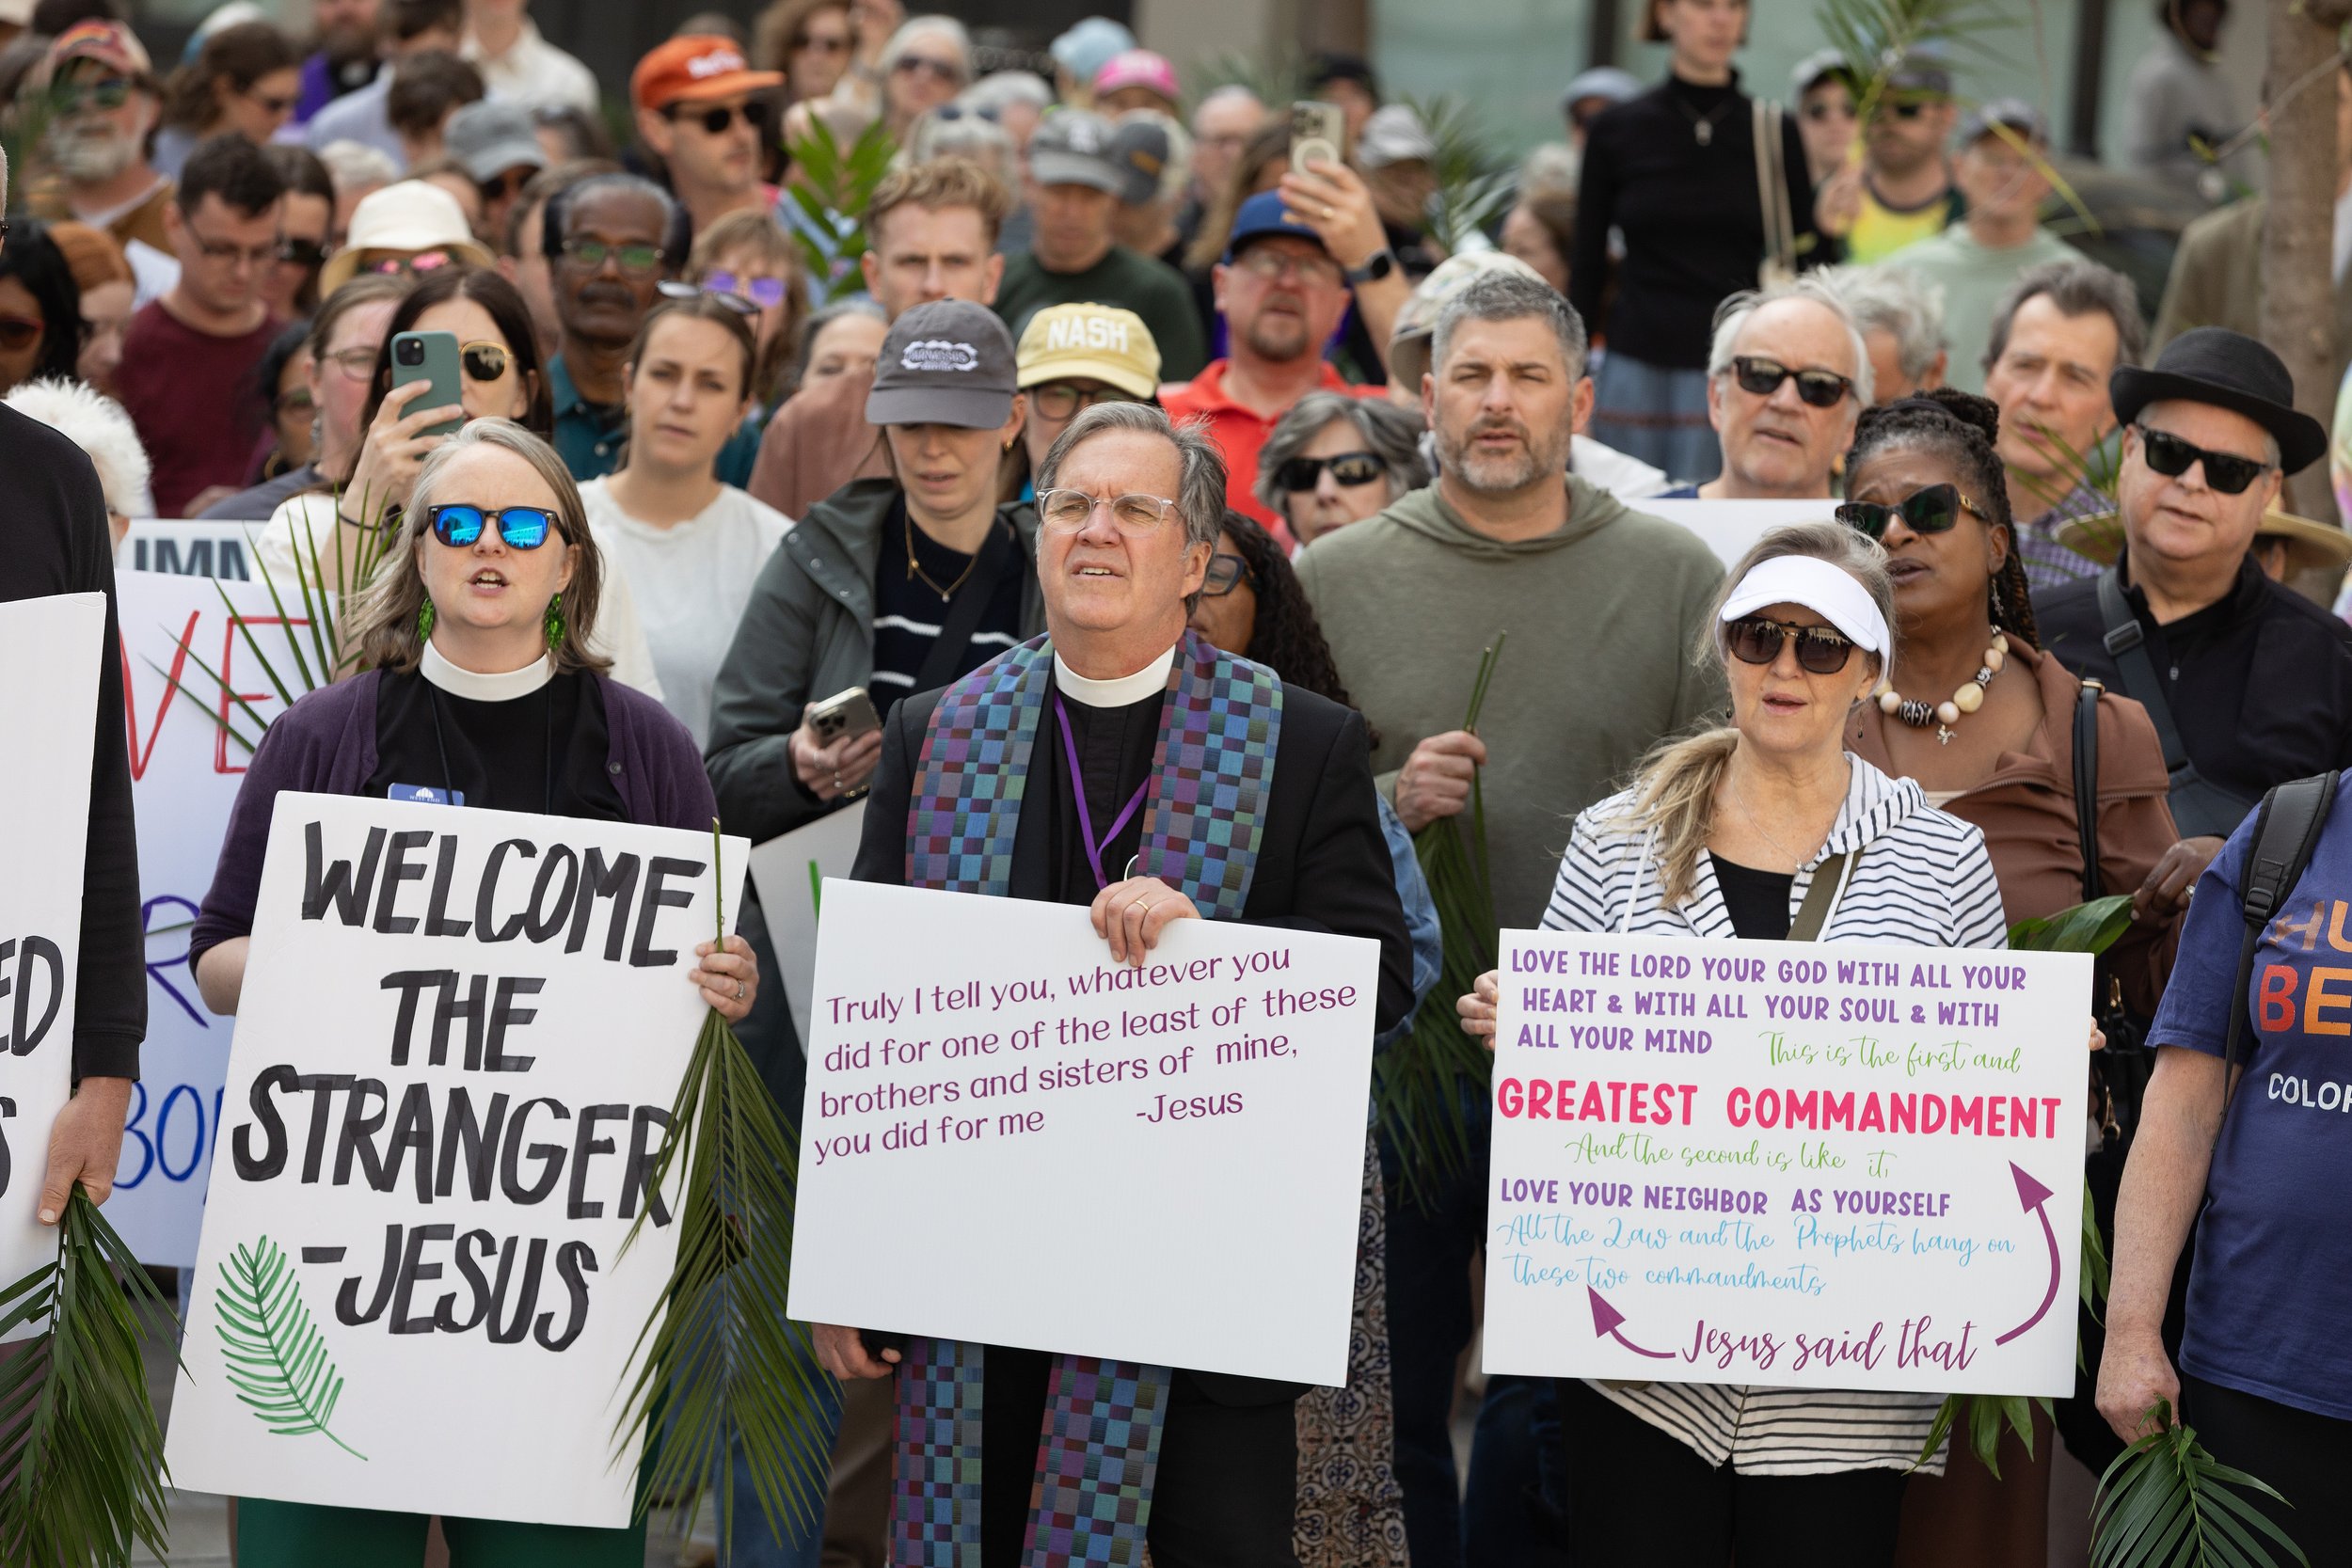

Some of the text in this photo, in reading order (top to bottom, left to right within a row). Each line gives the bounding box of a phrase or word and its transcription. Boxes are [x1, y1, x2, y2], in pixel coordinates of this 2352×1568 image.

[1047, 315, 1129, 354] NASH
[302, 821, 707, 967] WELCOME
[825, 948, 1290, 1025] Truly I tell you, whatever you
[1512, 948, 2026, 990] LOVE THE LORD YOUR GOD WITH ALL YOUR
[381, 970, 546, 1071] THE
[1522, 987, 1999, 1027] HEART & WITH ALL YOUR SOUL & WITH
[2259, 964, 2352, 1037] BE
[824, 986, 1356, 1072] did for one of the least of these
[1518, 1023, 1712, 1054] ALL YOUR MIND
[1758, 1031, 2020, 1077] This is the first and
[820, 1033, 1297, 1121] brothers and sisters of mine,
[1497, 1077, 2061, 1139] GREATEST COMMANDMENT
[113, 1082, 225, 1206] BO
[232, 1065, 679, 1227] STRANGER
[814, 1133, 870, 1165] you
[882, 1118, 928, 1150] did
[940, 1116, 989, 1144] for
[999, 1111, 1044, 1136] me
[1565, 1132, 1629, 1164] And
[1623, 1132, 1674, 1164] the
[1681, 1139, 1758, 1166] second
[1767, 1149, 1793, 1172] is
[1801, 1141, 1846, 1169] like
[1501, 1178, 1950, 1217] LOVE YOUR NEIGHBOR AS YOURSELF
[1496, 1212, 2015, 1267] All the Law and the Prophets hang on
[1502, 1253, 1825, 1295] these two commandments
[1681, 1315, 1978, 1371] Jesus said that
